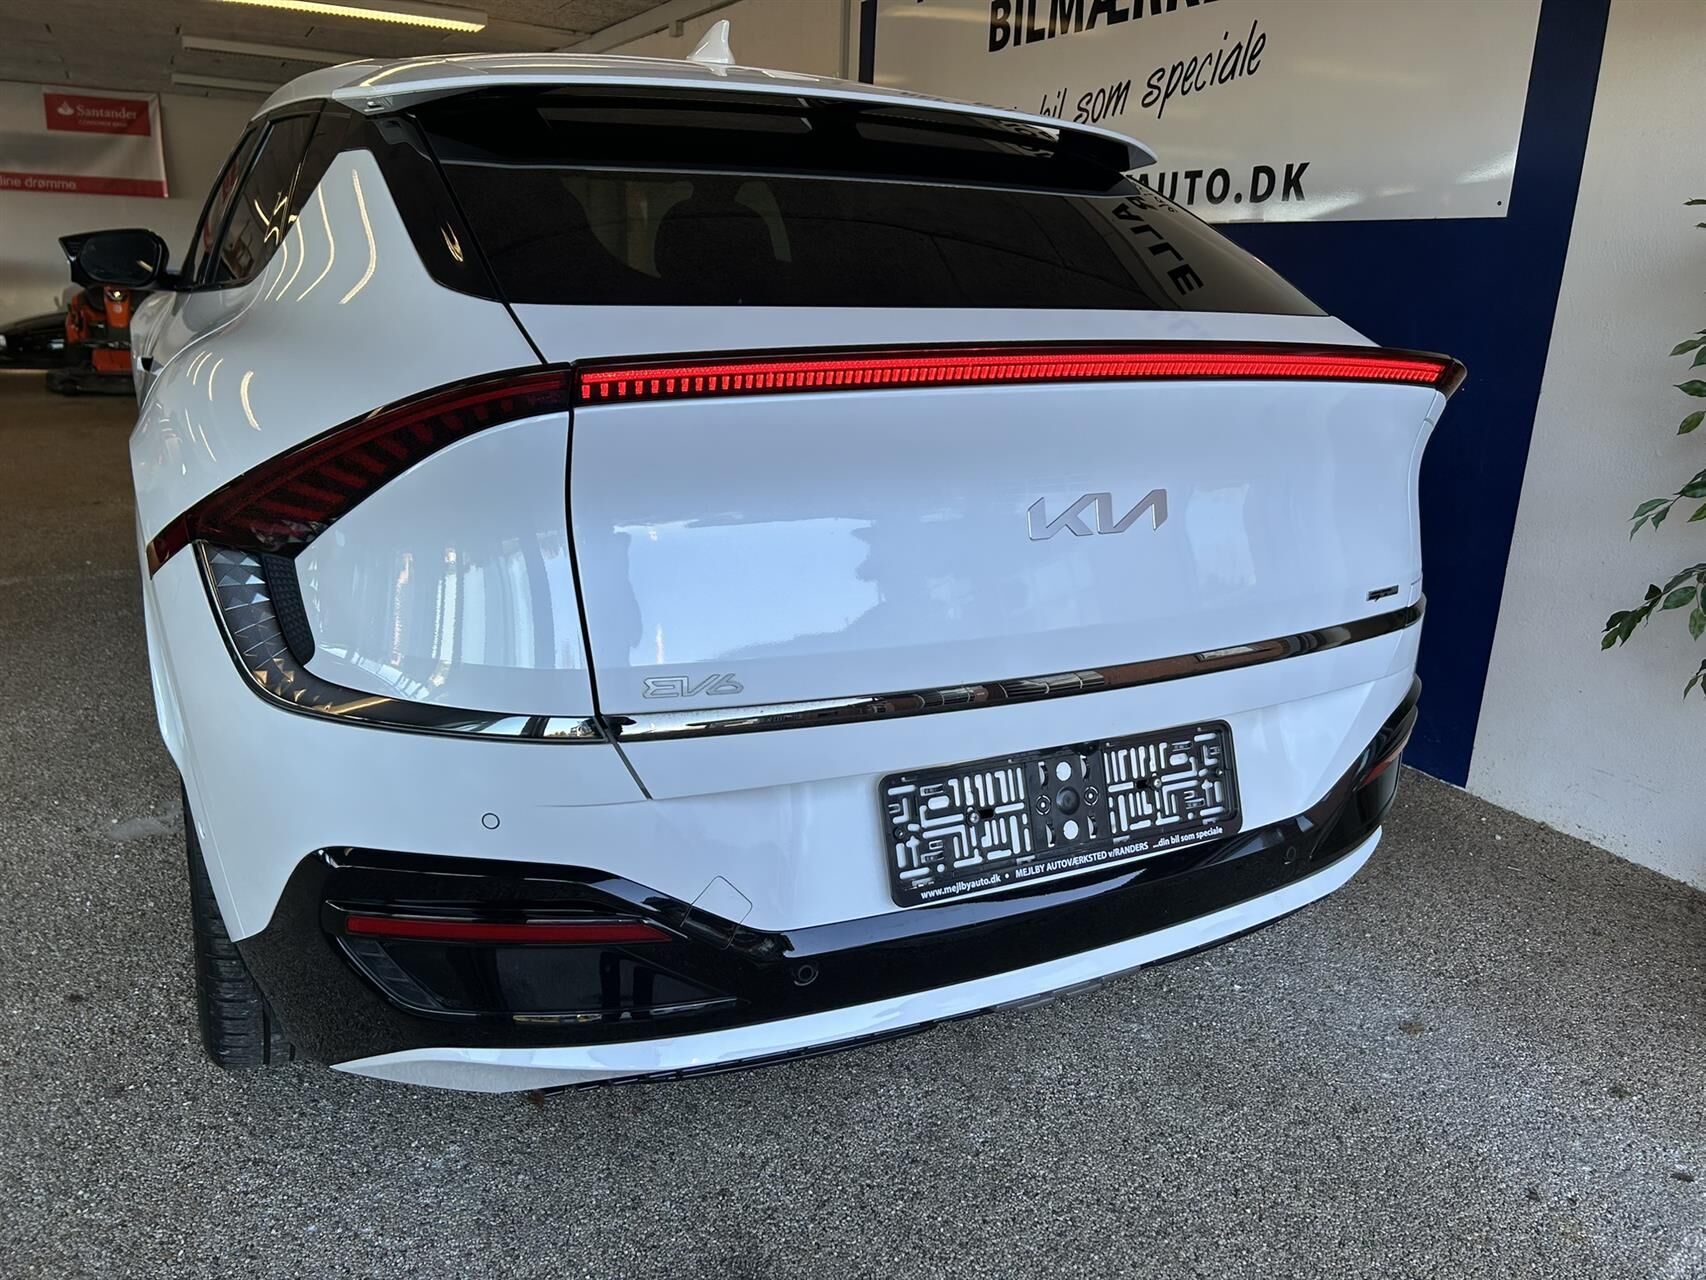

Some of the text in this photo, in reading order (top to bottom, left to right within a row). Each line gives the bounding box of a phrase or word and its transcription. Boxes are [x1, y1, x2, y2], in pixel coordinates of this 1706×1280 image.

[988, 0, 1220, 52] BILMÆ
[1073, 79, 1131, 125] som
[1141, 19, 1266, 119] speciale
[76, 104, 137, 120] Santander
[24, 177, 77, 190] drømme
[1027, 488, 1168, 541] KIA
[642, 673, 744, 699] EV6
[920, 873, 1002, 899] www.mejlbyauto.dk
[1015, 863, 1045, 878] MEJLBY
[1046, 850, 1107, 872] AUTOVÆRKSTED
[1107, 841, 1149, 858] v/RANDERS
[1170, 834, 1180, 845] bil
[1180, 832, 1195, 842] som
[1195, 826, 1223, 840] speciale
